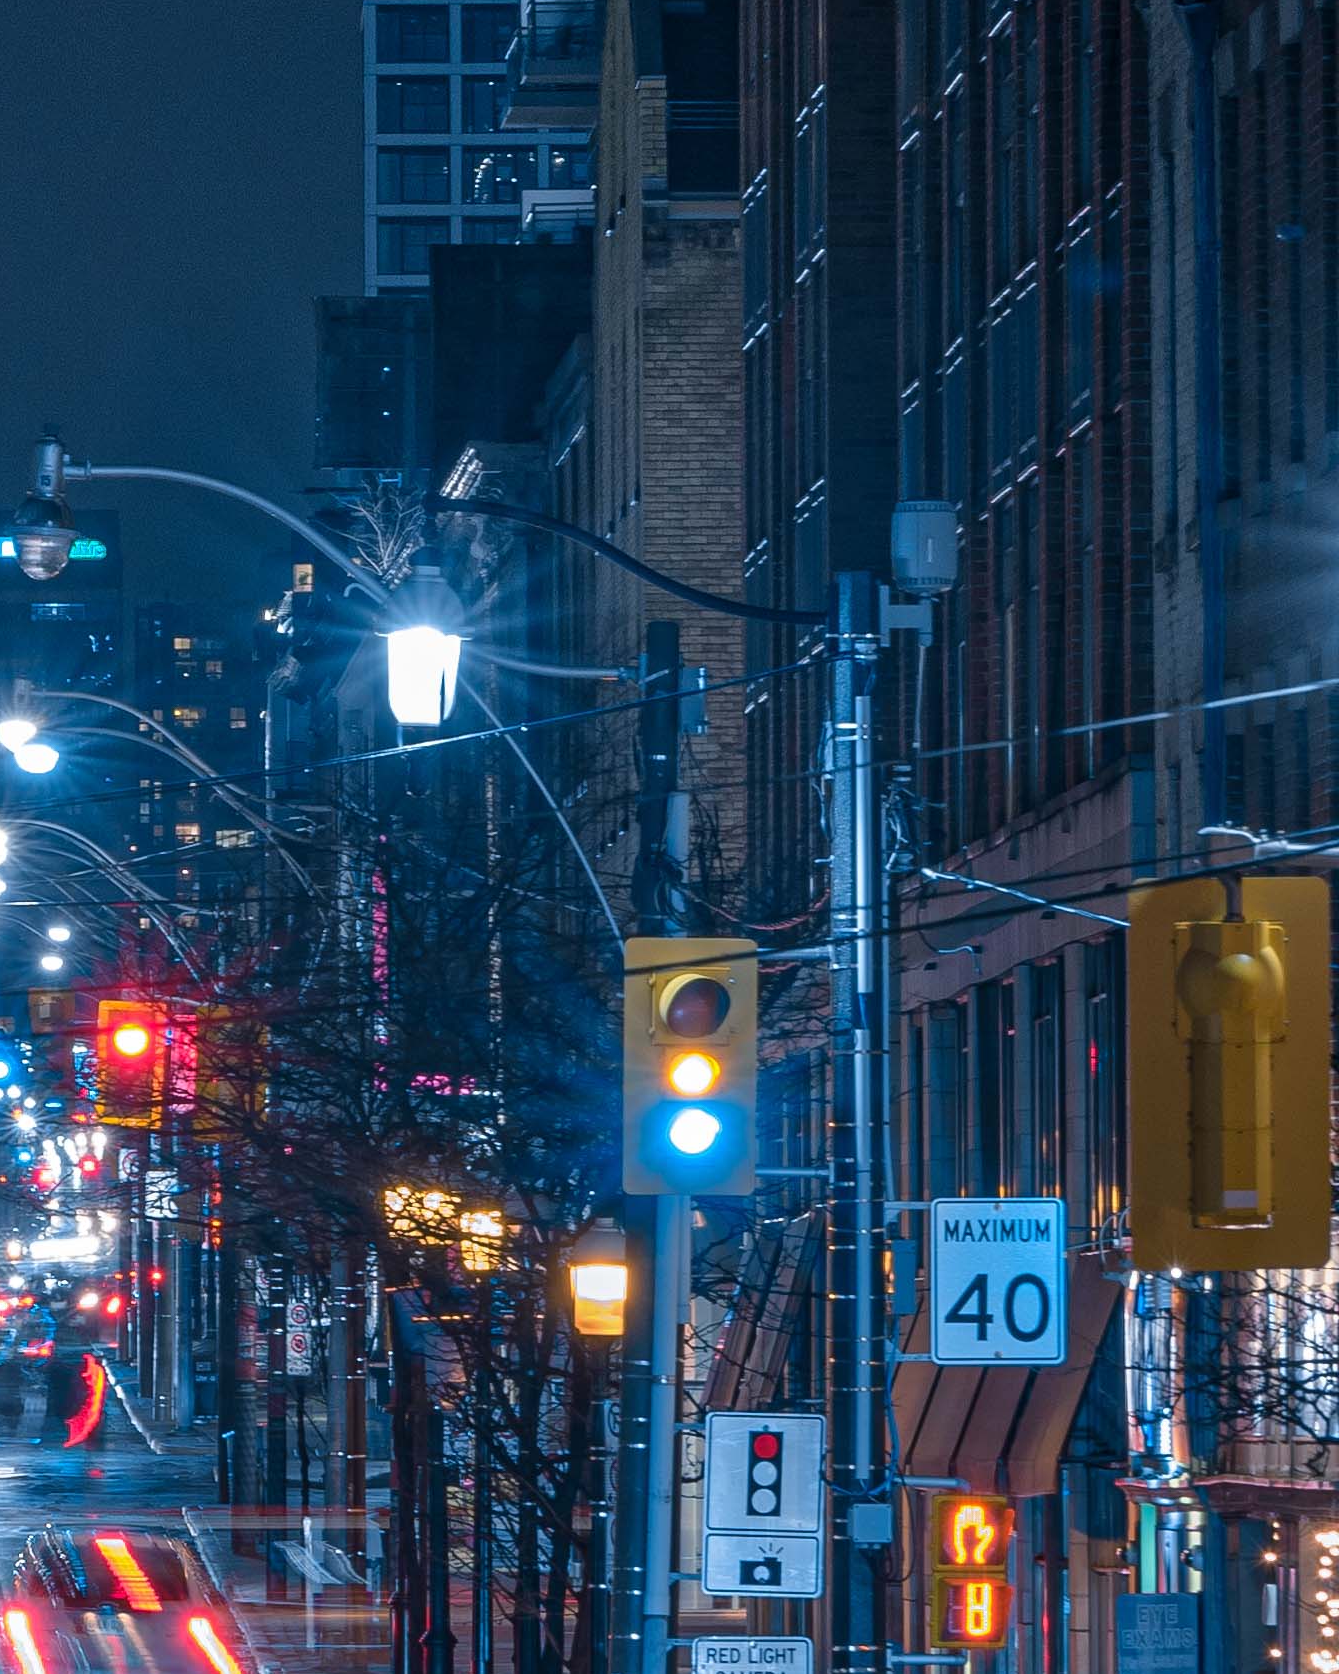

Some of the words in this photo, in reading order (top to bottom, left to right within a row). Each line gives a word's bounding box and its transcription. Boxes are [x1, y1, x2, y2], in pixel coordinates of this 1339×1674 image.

[944, 1219, 1051, 1242] MAXIMUM
[944, 1273, 1050, 1342] 40
[1138, 1604, 1179, 1624] EYE
[1122, 1628, 1195, 1648] EXAMS
[706, 1648, 741, 1663] RED
[748, 1648, 797, 1663] LIGHT
